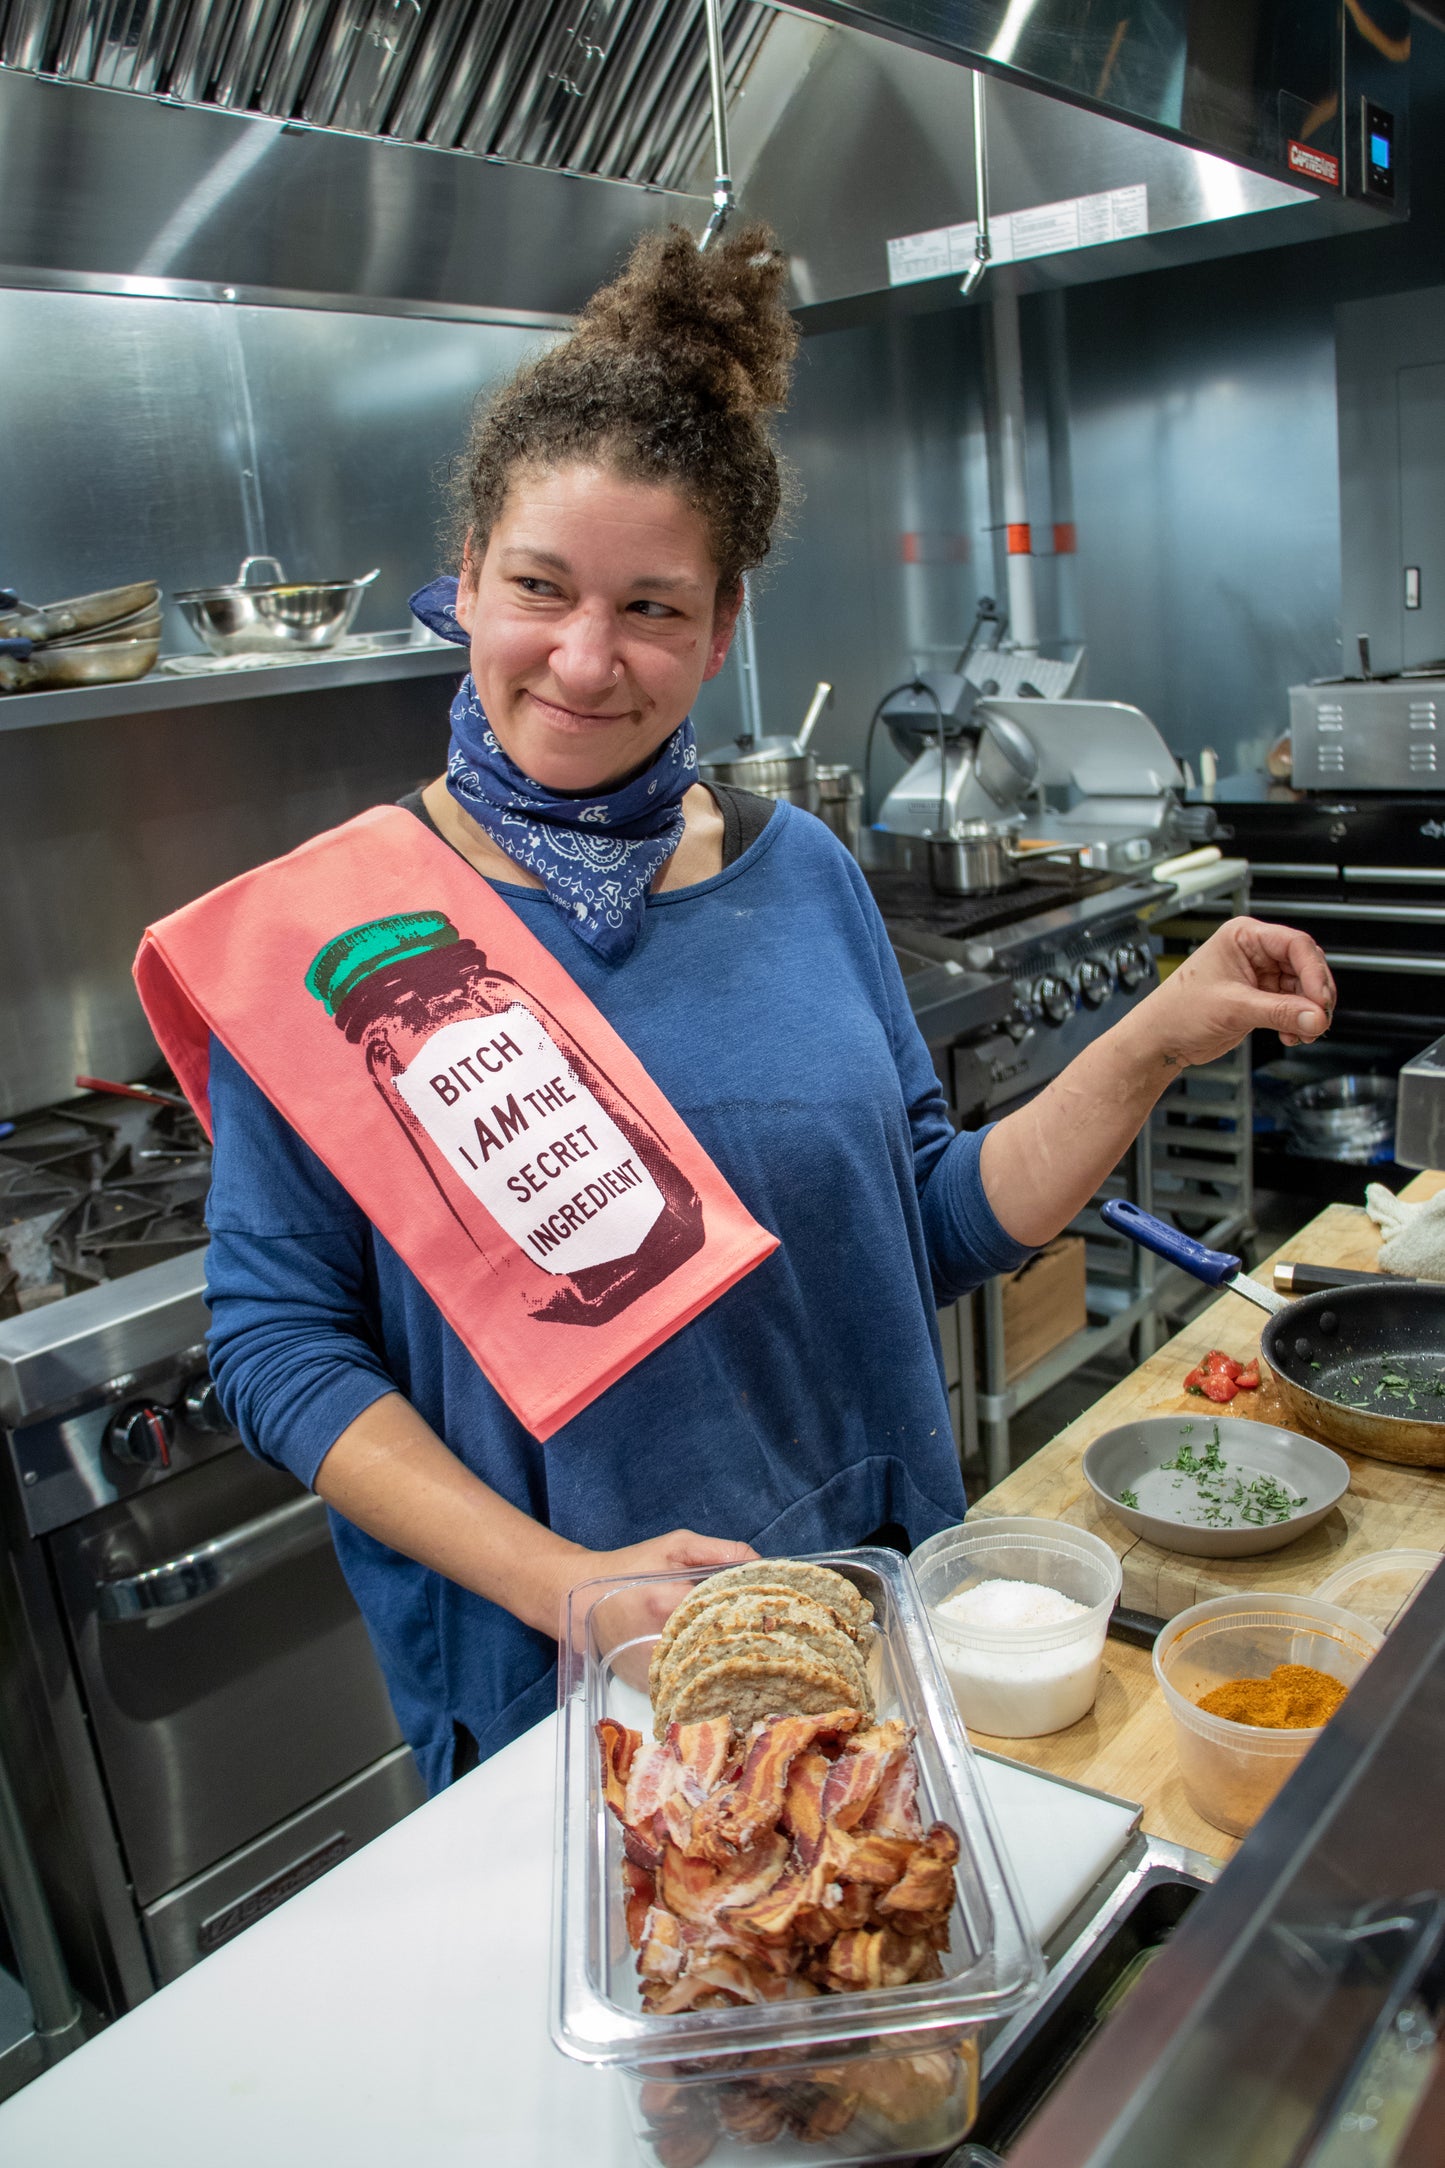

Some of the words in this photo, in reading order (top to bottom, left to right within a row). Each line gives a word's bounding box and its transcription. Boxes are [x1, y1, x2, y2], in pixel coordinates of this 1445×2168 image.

[586, 916, 599, 930] TM
[429, 1031, 523, 1107] BITCH
[458, 1146, 479, 1171] I
[473, 1093, 530, 1163] AM
[522, 1076, 577, 1118] THE
[506, 1124, 599, 1203] SECRET
[526, 1158, 643, 1257] INGREDIENT
